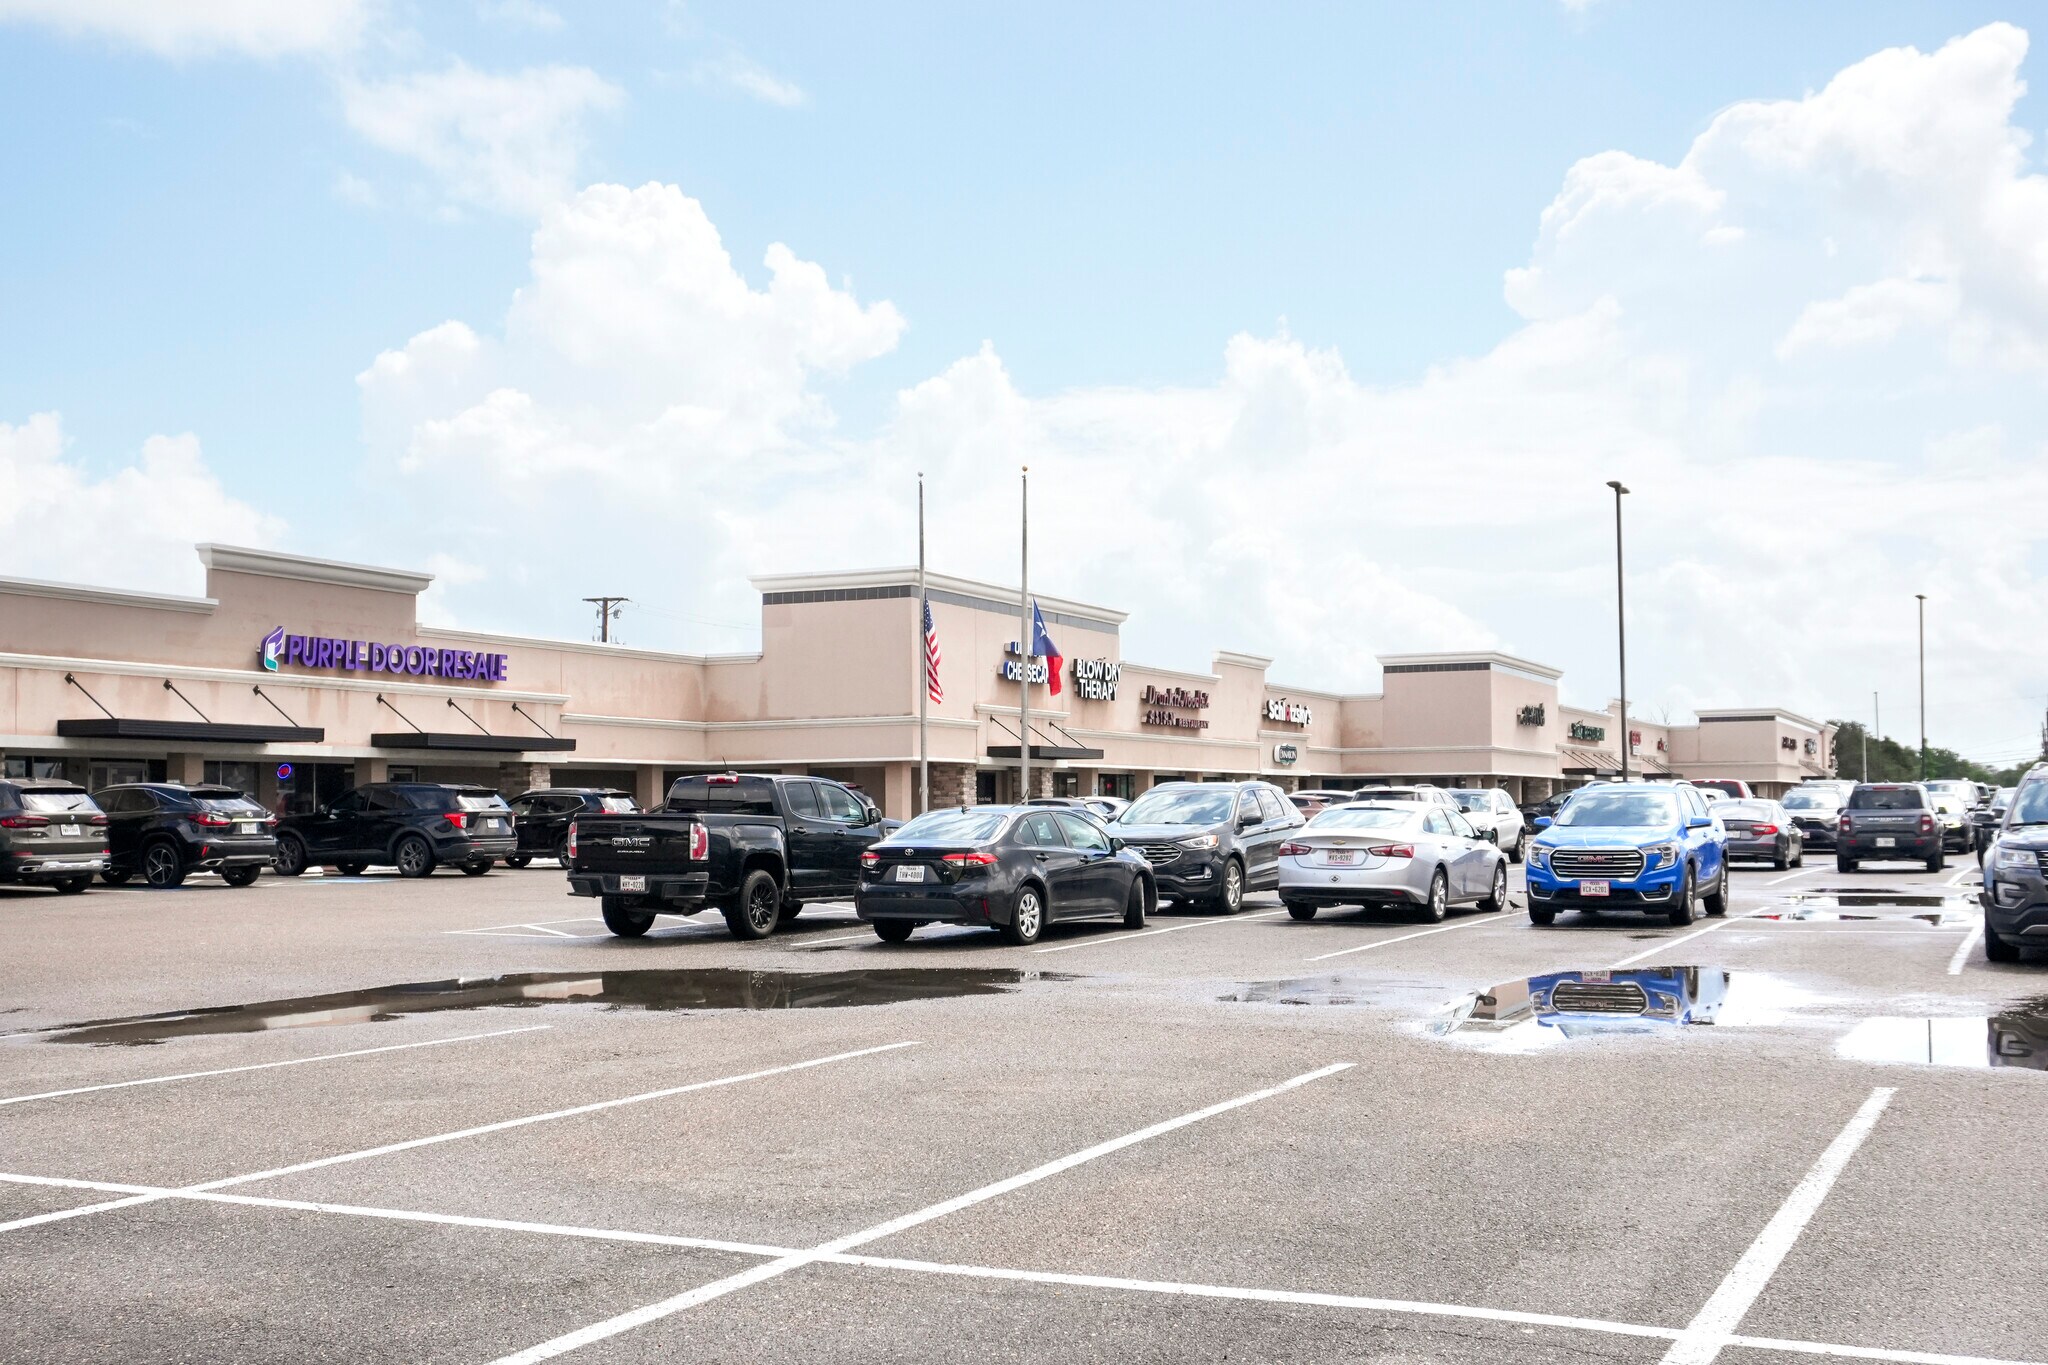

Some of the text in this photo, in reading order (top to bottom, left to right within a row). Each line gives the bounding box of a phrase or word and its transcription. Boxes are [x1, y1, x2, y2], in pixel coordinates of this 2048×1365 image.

[284, 634, 508, 681] PURPLE DOOR RESALE
[1074, 658, 1123, 682] BLOW DRY
[1078, 678, 1118, 700] THERAPY
[1178, 718, 1209, 729] RESTAURANT
[611, 837, 650, 847] GMC
[1577, 855, 1612, 863] GMC
